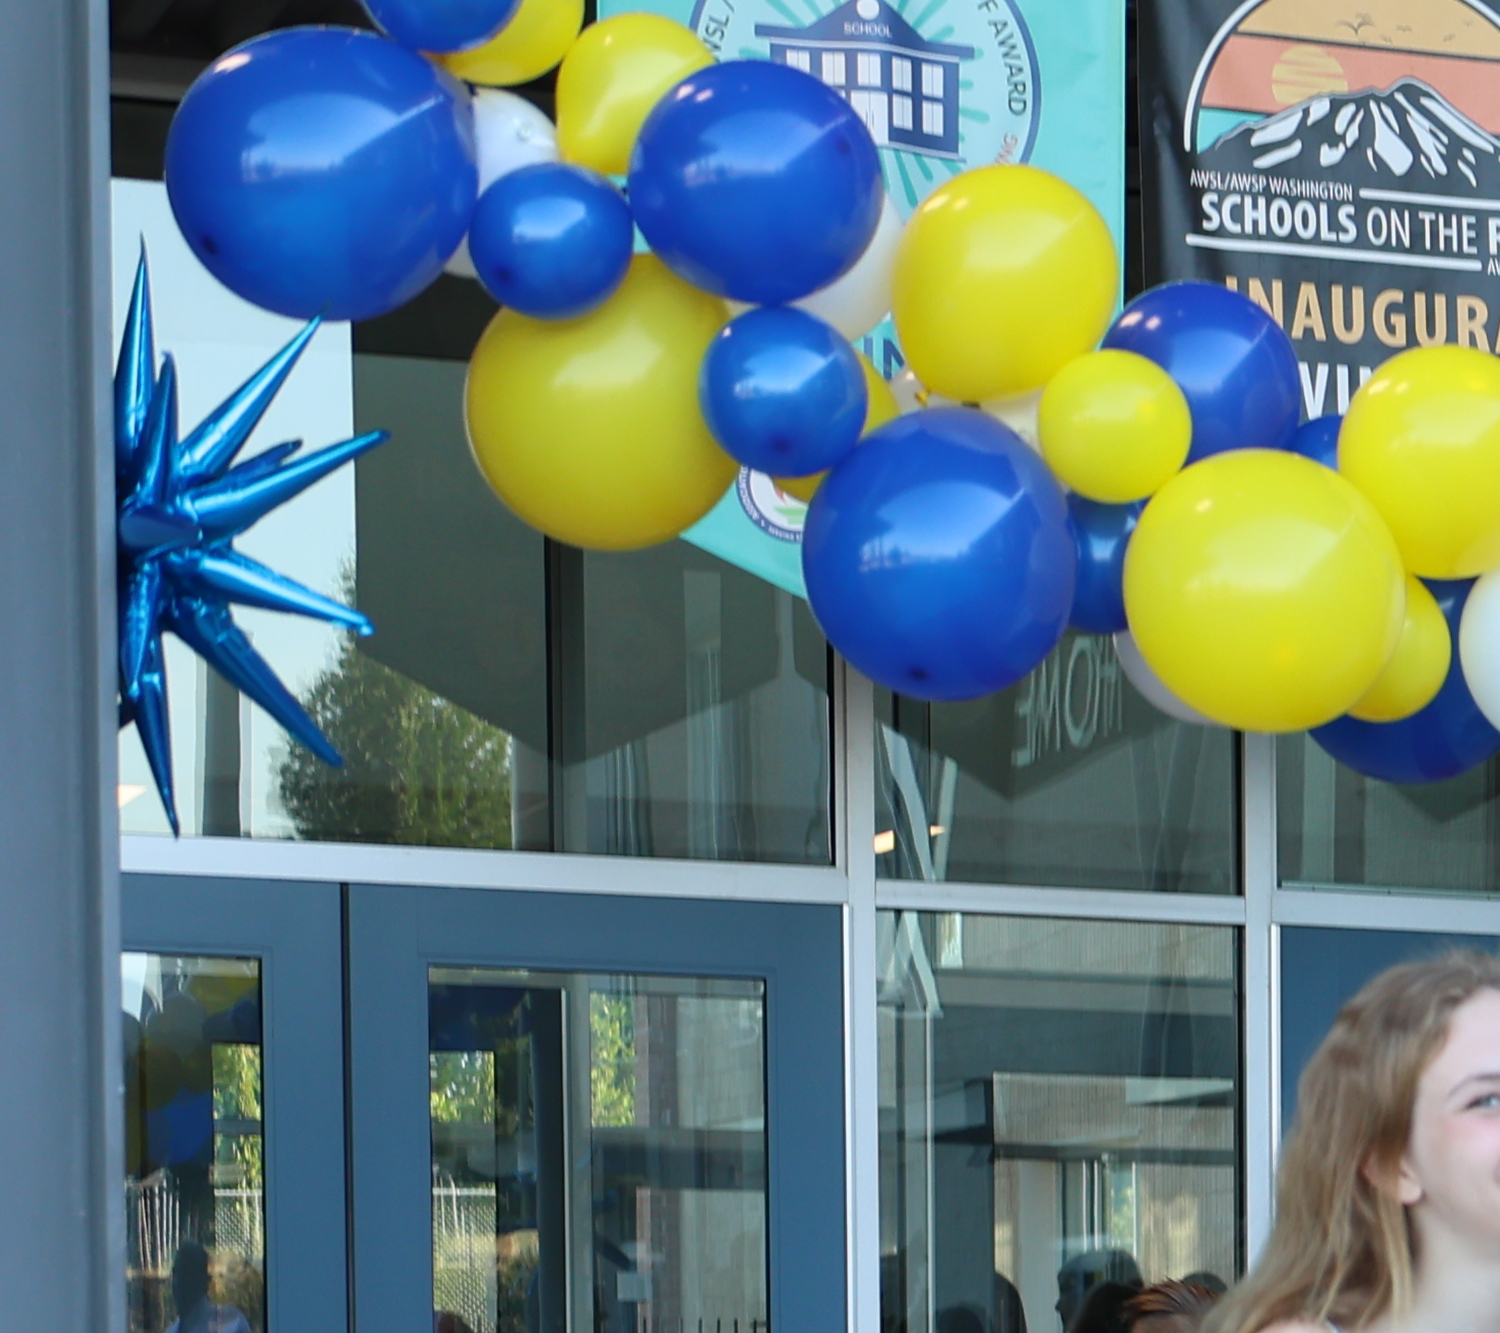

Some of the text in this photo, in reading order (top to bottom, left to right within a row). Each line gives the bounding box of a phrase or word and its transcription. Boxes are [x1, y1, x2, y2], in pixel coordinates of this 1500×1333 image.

[843, 20, 893, 39] SCHOOL
[988, 19, 1027, 116] AWARD
[1189, 168, 1353, 202] AWSL/AWSP WASHINGTON
[1201, 191, 1358, 244] SCHOOLS
[1366, 206, 1411, 249] ON
[1418, 210, 1478, 255] THE
